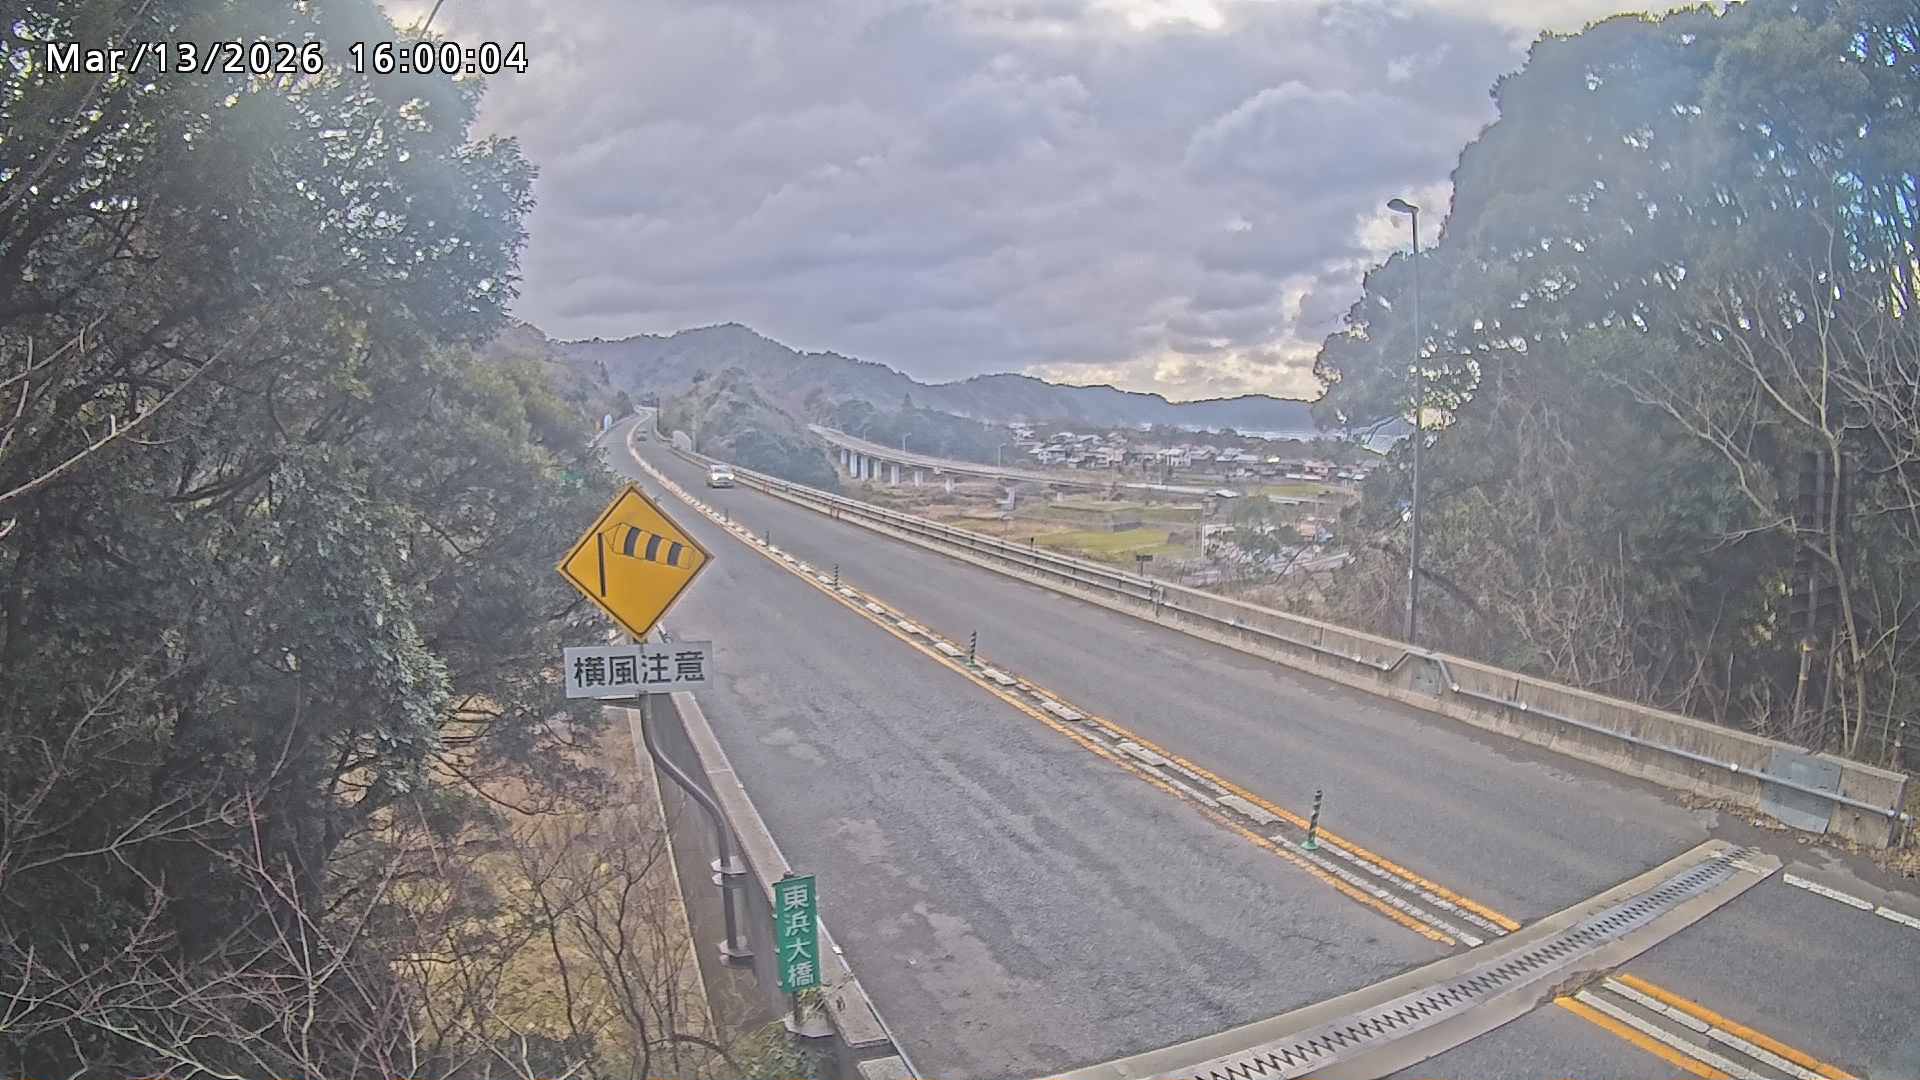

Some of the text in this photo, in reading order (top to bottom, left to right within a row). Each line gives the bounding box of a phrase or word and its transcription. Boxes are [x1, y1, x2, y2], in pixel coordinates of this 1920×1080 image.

[574, 651, 705, 688] 横風注意
[783, 884, 814, 988] 東浜大橋
